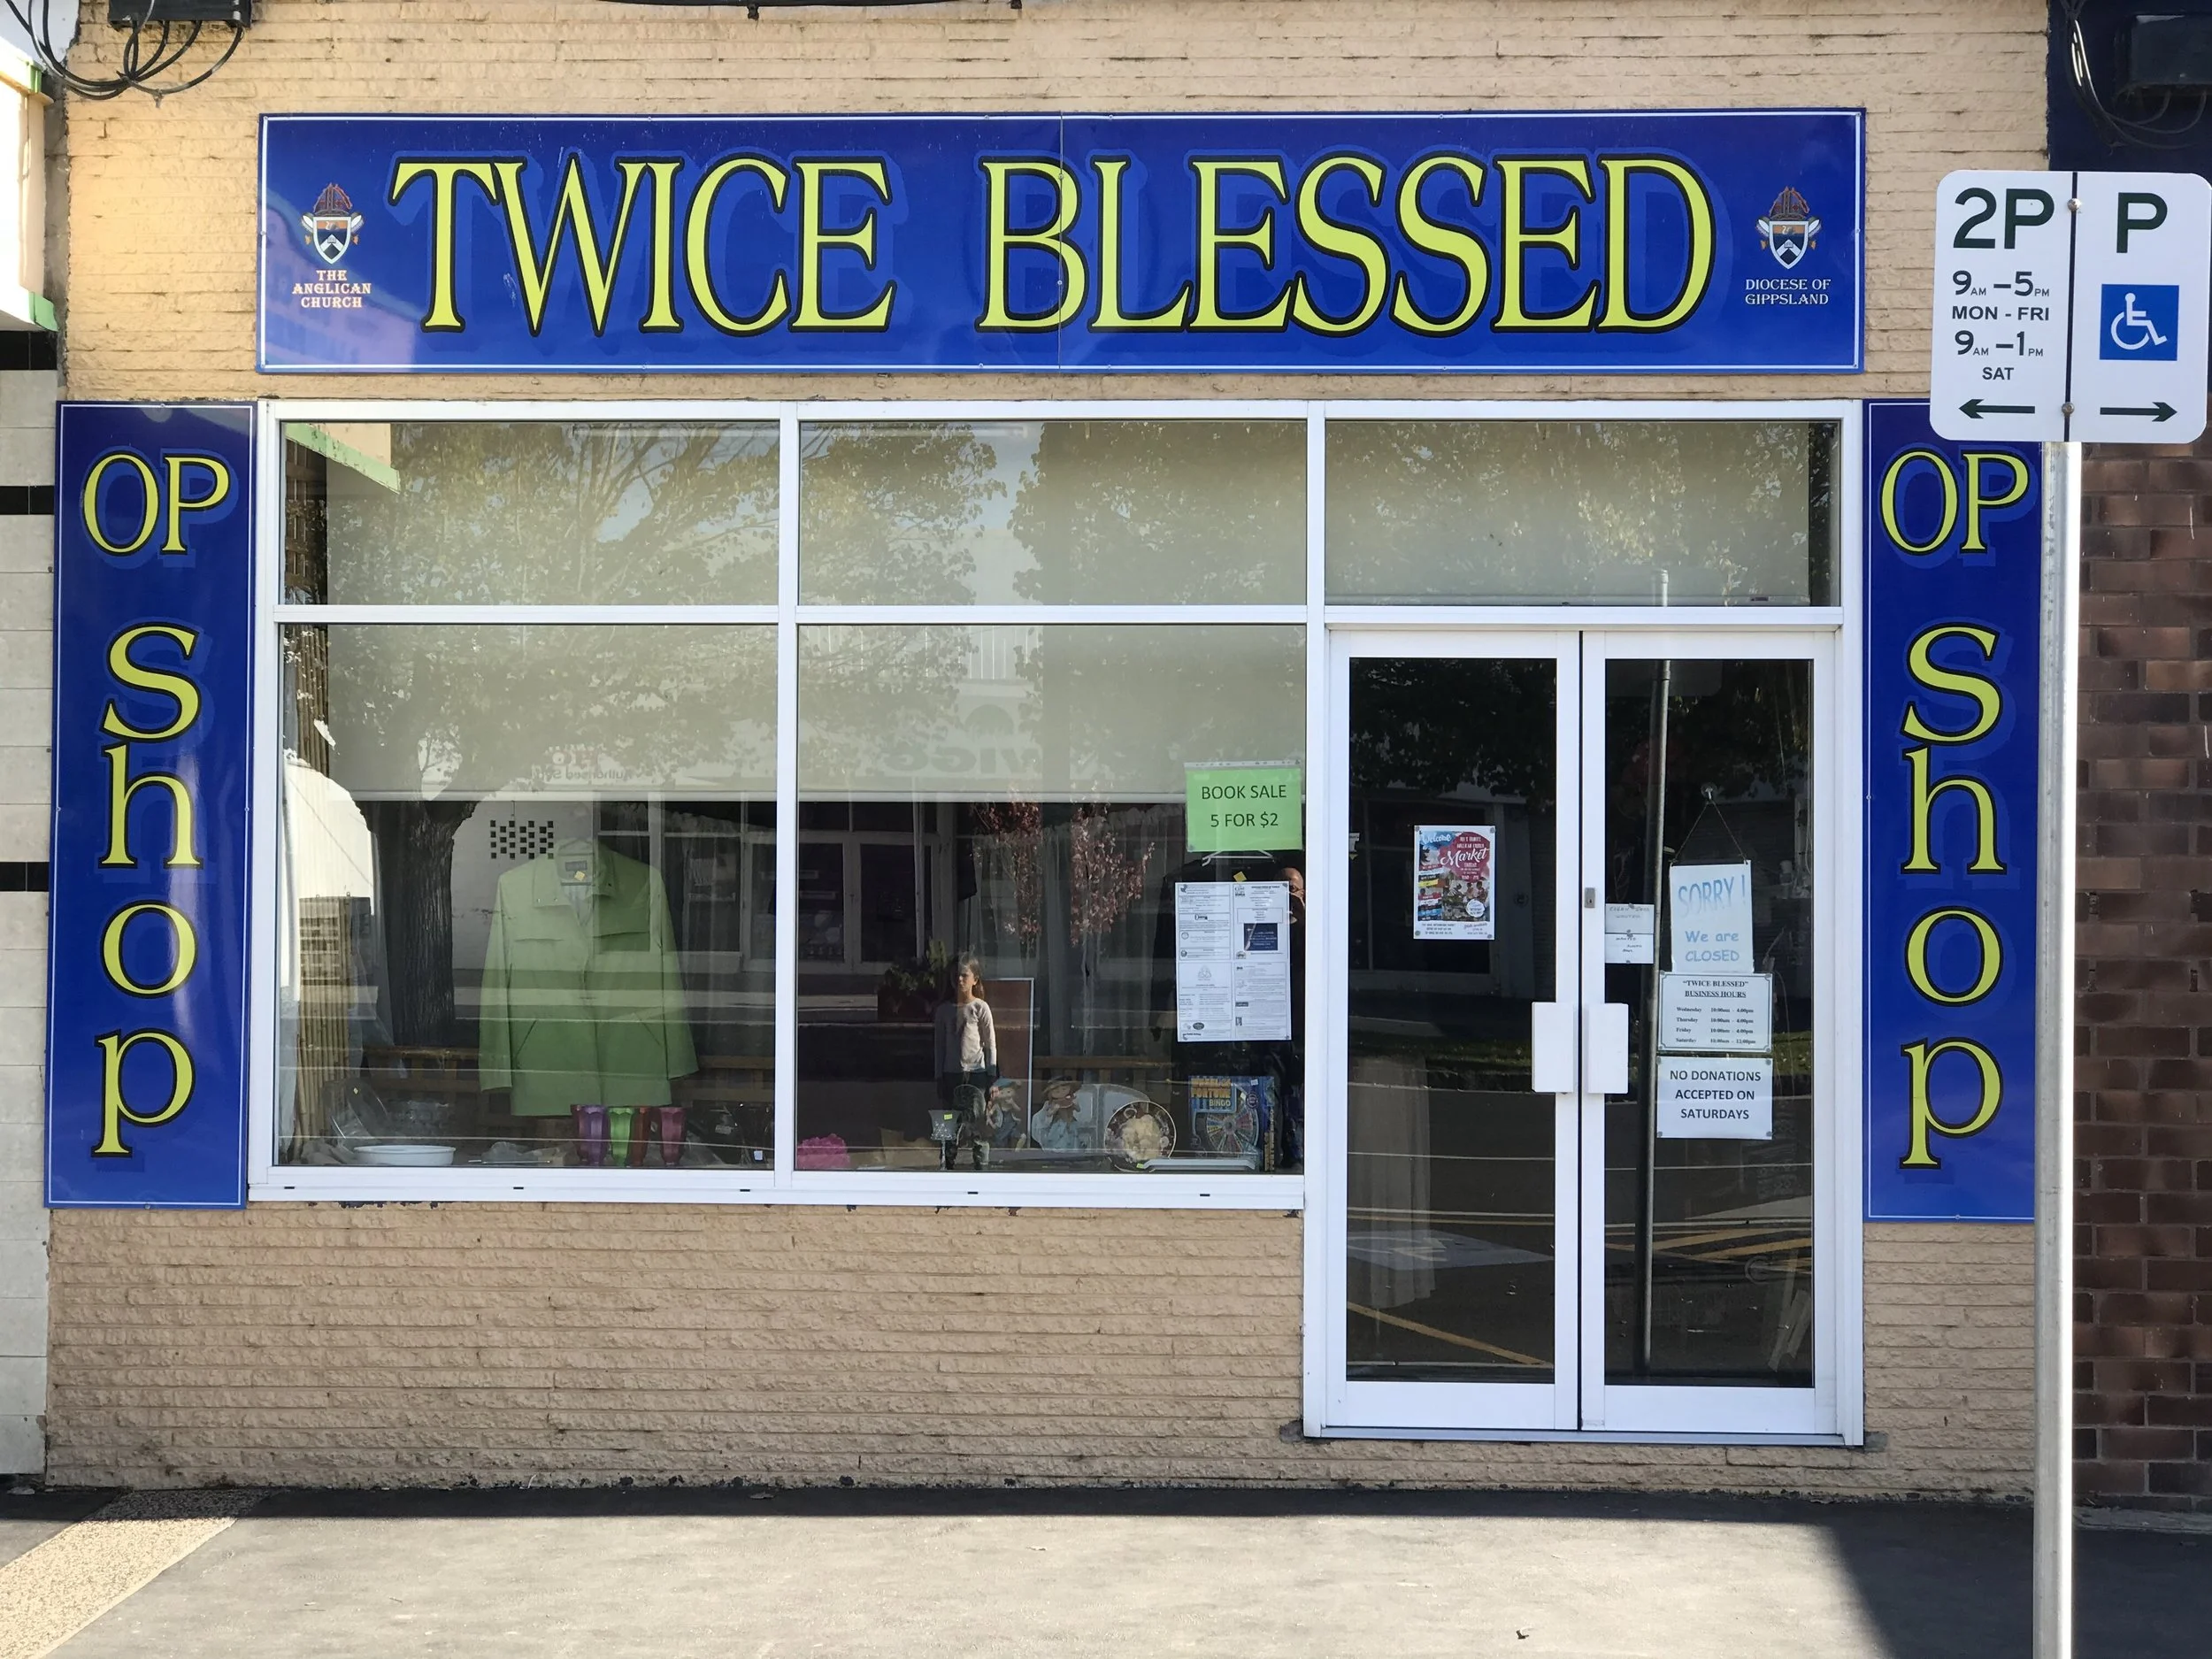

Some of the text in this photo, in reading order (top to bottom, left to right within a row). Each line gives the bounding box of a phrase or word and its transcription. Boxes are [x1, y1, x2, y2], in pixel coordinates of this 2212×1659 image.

[1953, 187, 2055, 250] 2P
[2116, 192, 2168, 253] P
[388, 152, 1715, 336] TWICE BLESSED
[316, 270, 348, 281] THE
[292, 283, 372, 295] ANGLICAN
[1745, 279, 1832, 290] DIOCESE OF
[301, 296, 363, 308] CHURCH
[1745, 293, 1829, 305] GIPPSLAND
[1952, 306, 1998, 320] MON
[2017, 307, 2049, 321] FRI
[1982, 367, 2015, 380] SAT
[83, 452, 230, 555] OP
[1879, 450, 2031, 555] OP
[1202, 784, 1287, 800] BOOK SALE
[1210, 810, 1279, 828] 5 FOR $2
[1440, 847, 1490, 867] Market
[1678, 876, 1735, 918] SORRY
[1685, 931, 1740, 943] We are
[1685, 949, 1740, 962] CLOSED
[1670, 1070, 1762, 1081] NO DONATIONS
[1675, 1089, 1755, 1100] ACCEPTED ON
[1209, 1098, 1231, 1107] BINGO
[1680, 1109, 1749, 1119] SATURDAYS
